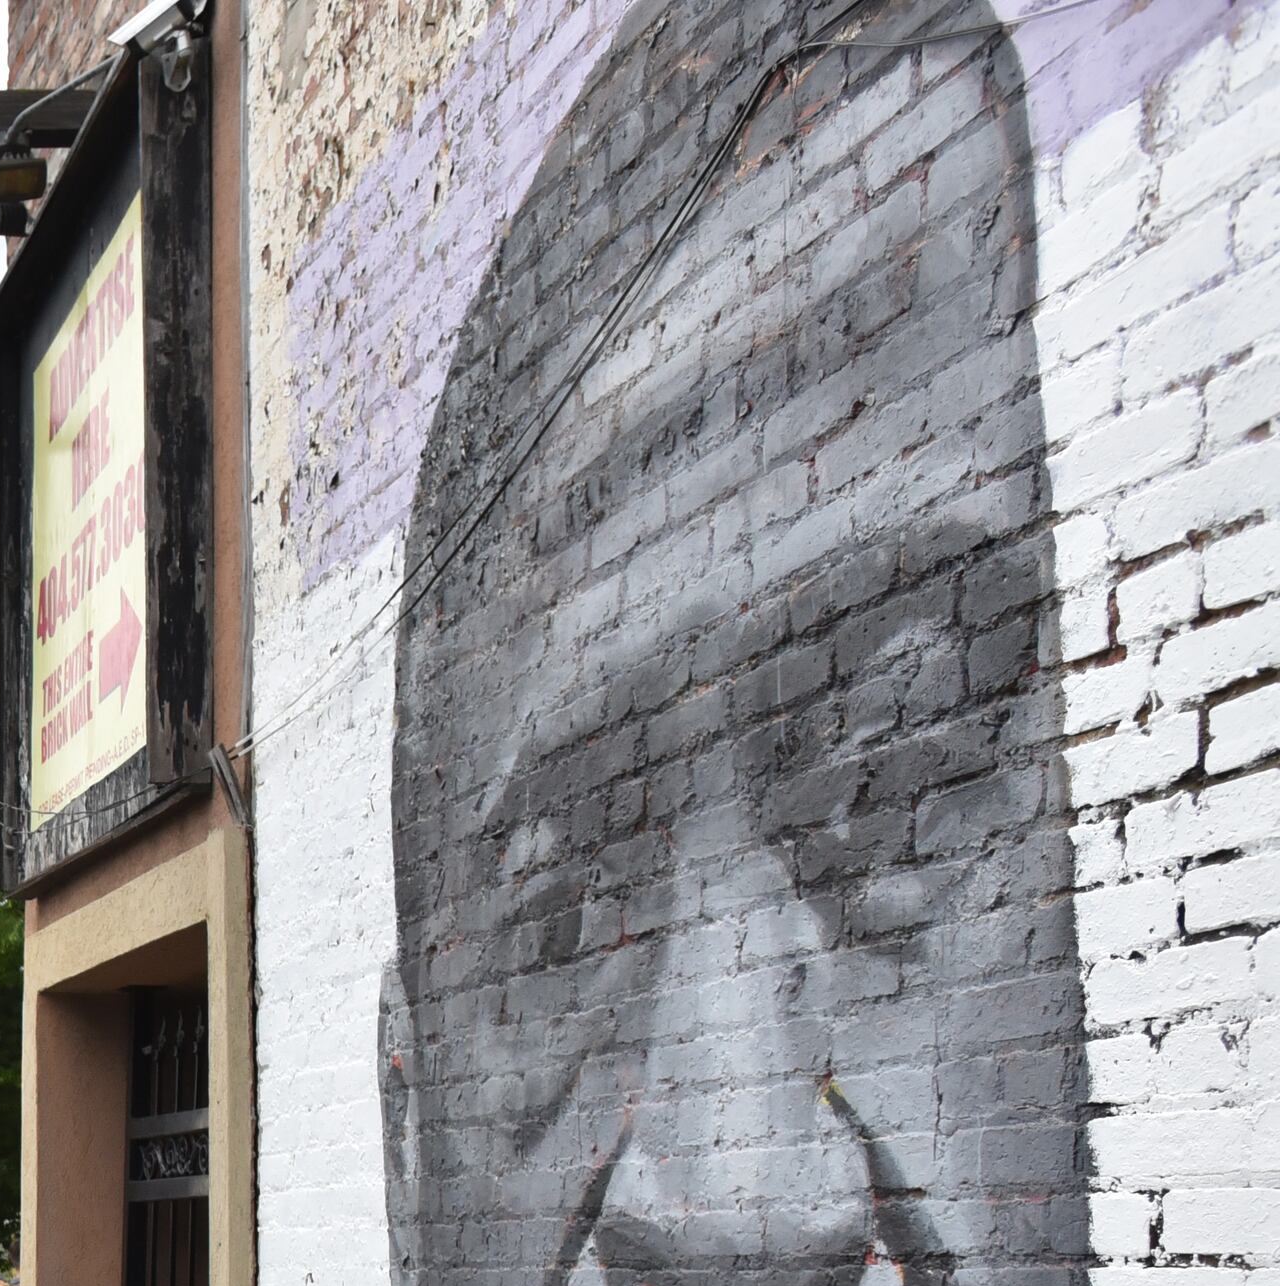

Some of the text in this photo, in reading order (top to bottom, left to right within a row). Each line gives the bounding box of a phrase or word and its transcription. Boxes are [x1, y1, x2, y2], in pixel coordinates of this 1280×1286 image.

[49, 232, 134, 444] ADVERTISE
[72, 386, 110, 512] HERE
[41, 681, 93, 765] BRICK WALL
[43, 630, 93, 718] THIS ENTIRE
